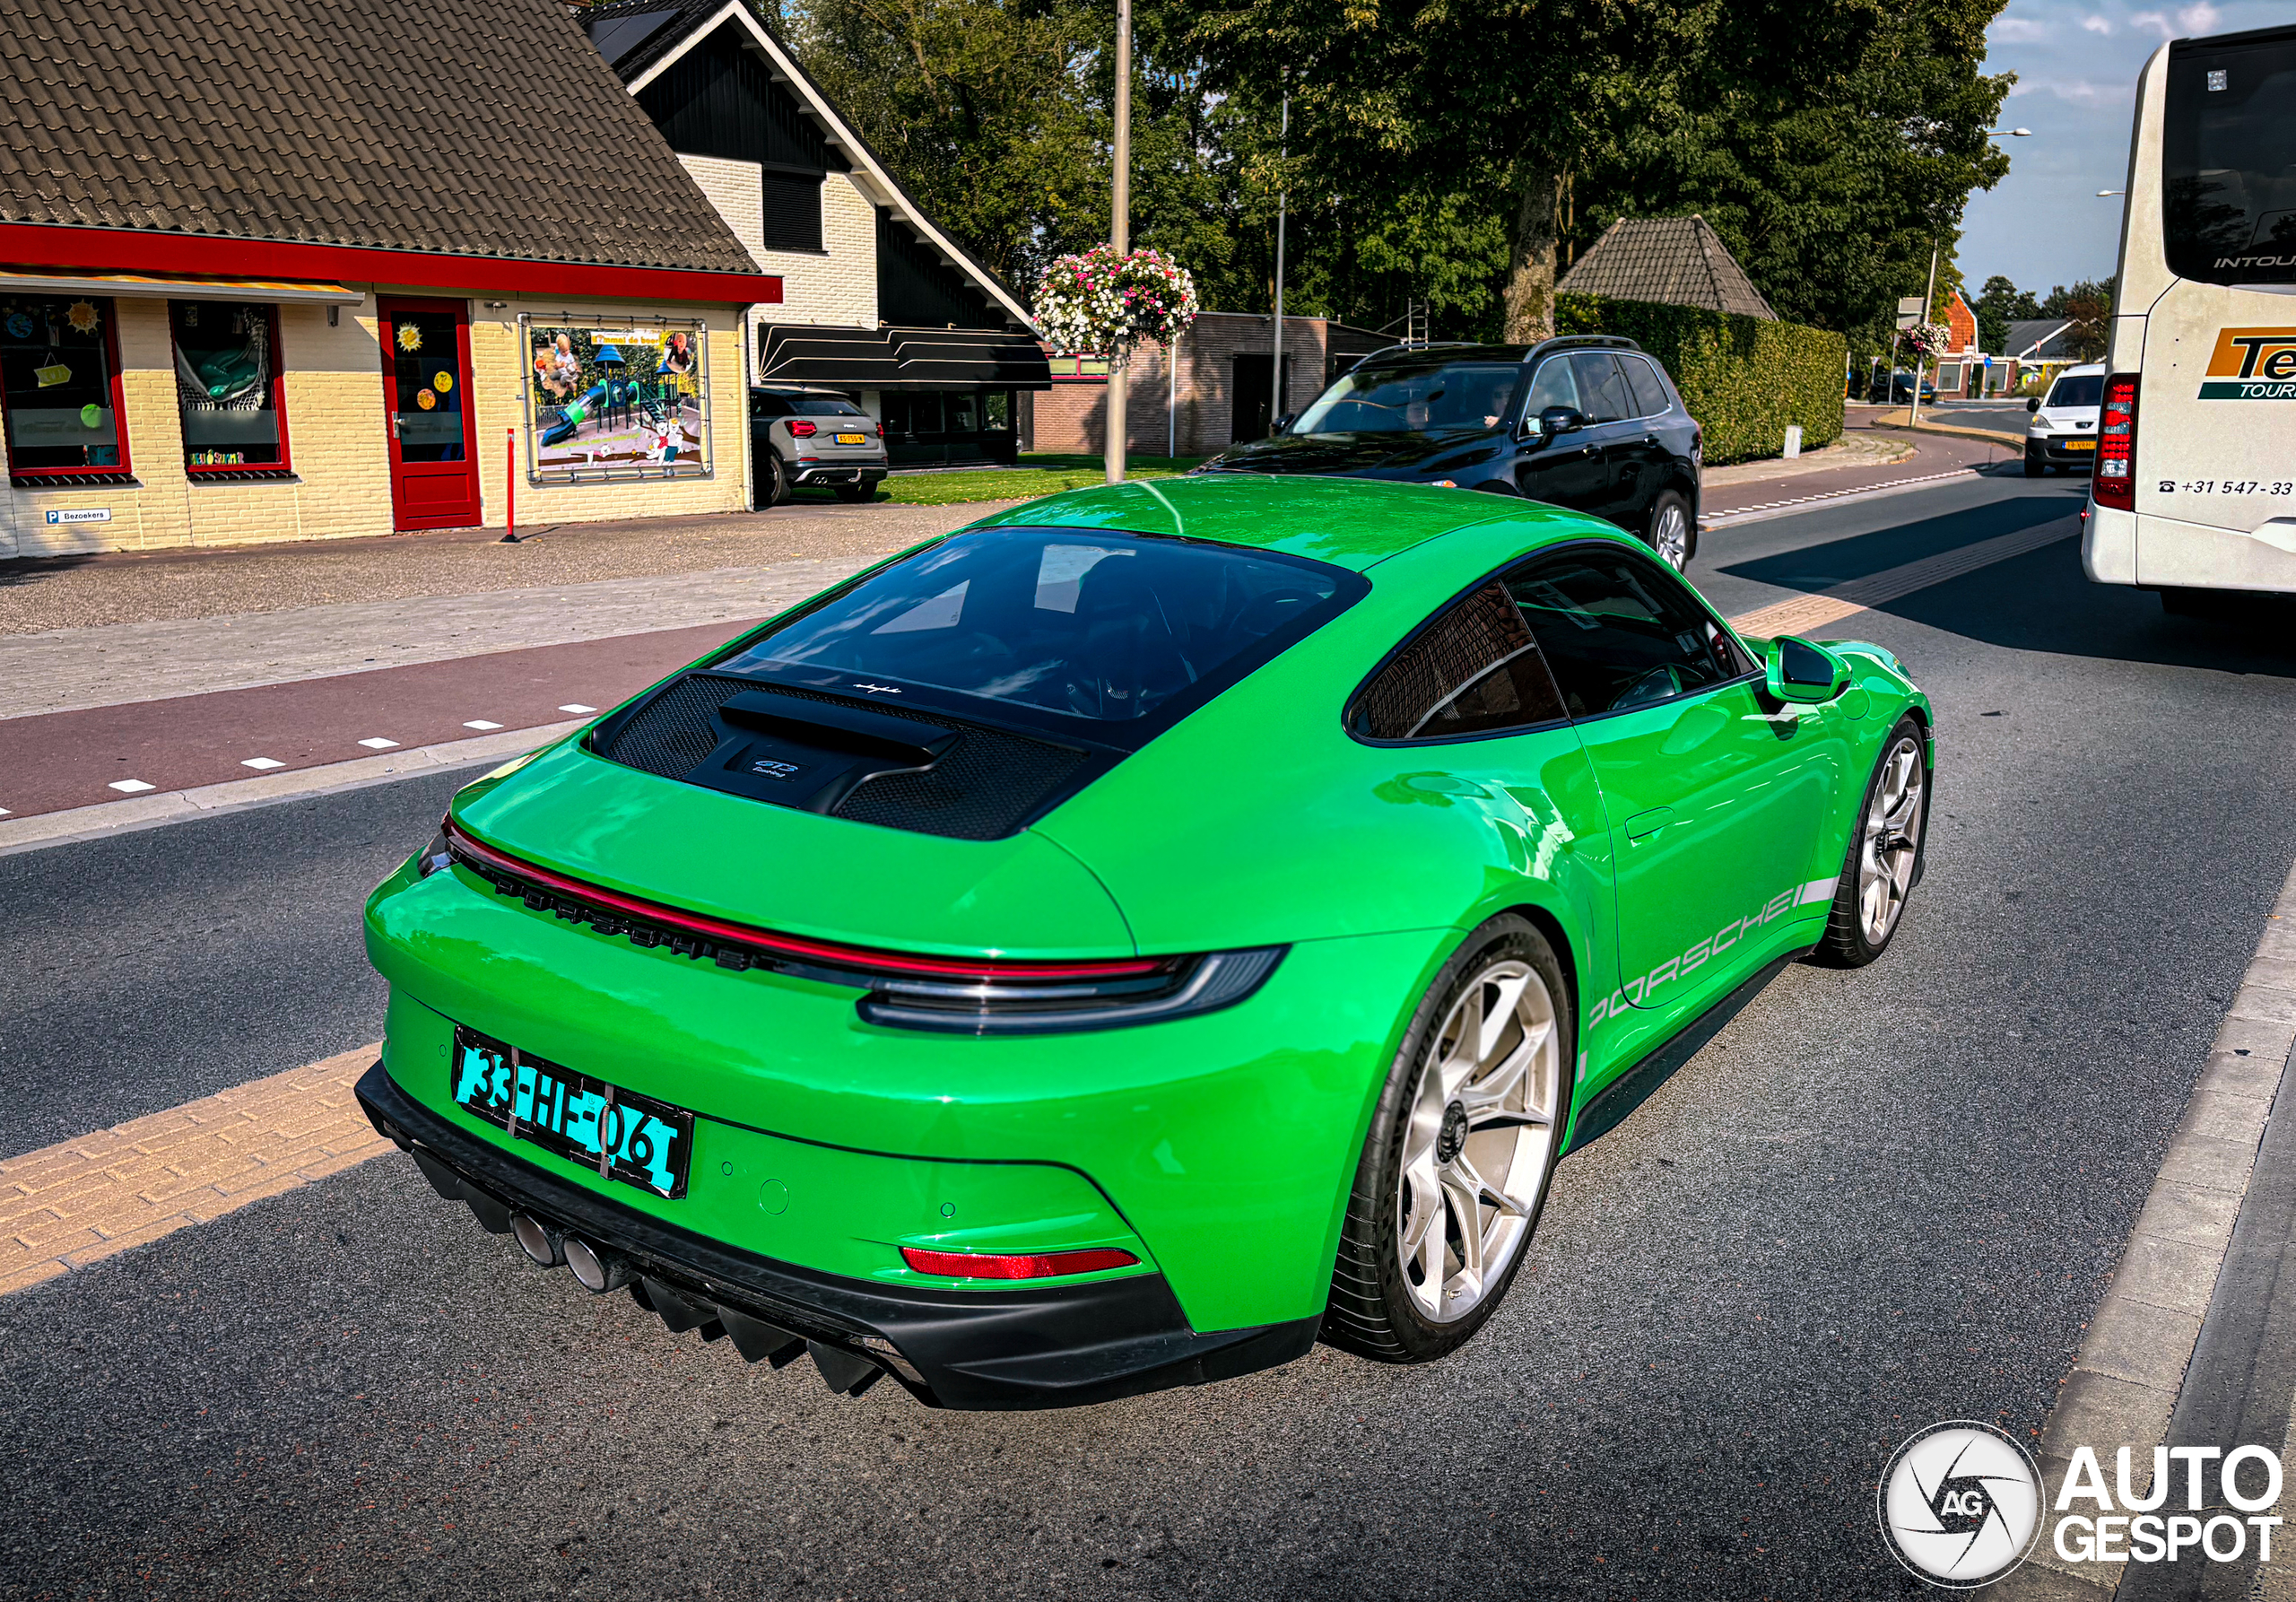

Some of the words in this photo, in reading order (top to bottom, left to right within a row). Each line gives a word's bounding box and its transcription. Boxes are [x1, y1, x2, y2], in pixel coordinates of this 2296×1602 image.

[2213, 256, 2296, 268] INTOU
[2240, 384, 2296, 397] TOUR
[2182, 481, 2214, 493] +31
[64, 512, 104, 520] Bezoekers
[754, 760, 799, 772] GT3
[1588, 887, 1795, 1032] PORSCHE
[473, 1049, 655, 1167] 33-HF-06
